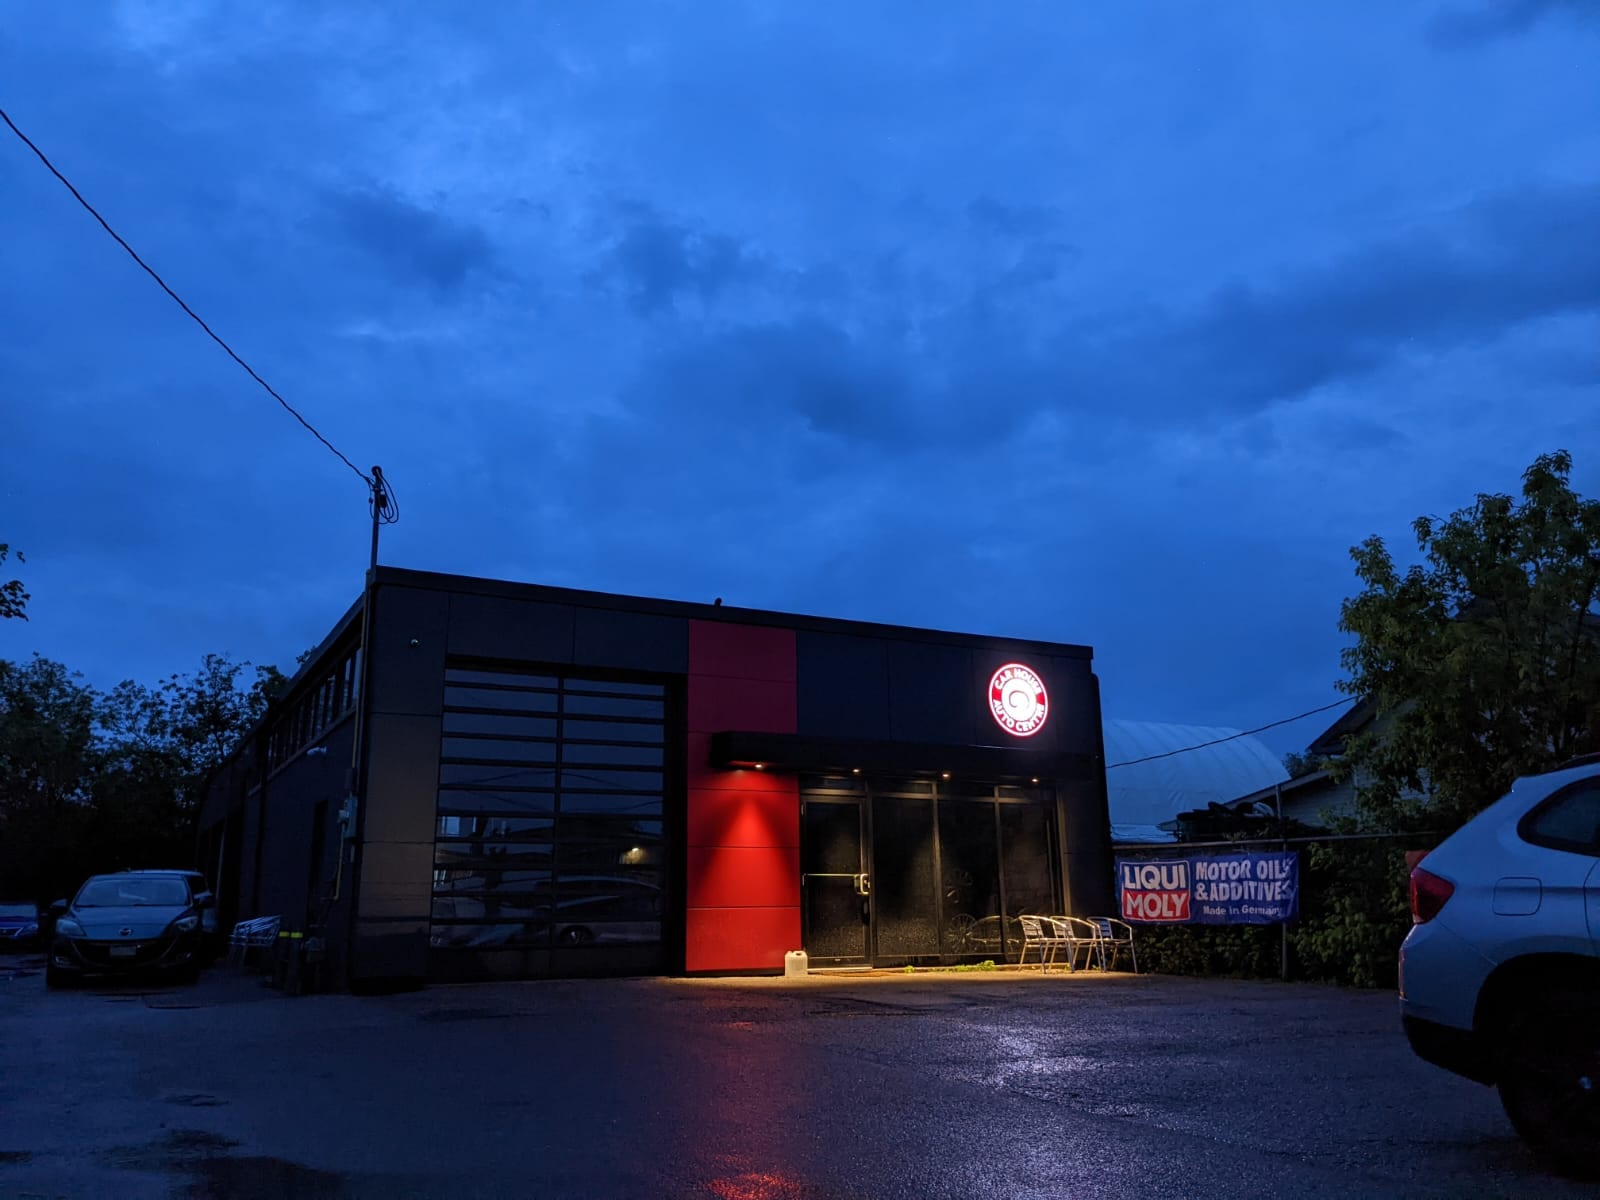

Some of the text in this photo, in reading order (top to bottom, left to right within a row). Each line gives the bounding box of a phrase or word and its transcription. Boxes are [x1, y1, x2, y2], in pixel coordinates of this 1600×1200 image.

[994, 670, 1013, 690] CAR
[993, 699, 1015, 727] AUTO
[1123, 864, 1186, 890] LIQUI
[1195, 860, 1251, 880] MOTOR
[1126, 892, 1187, 918] MOLY
[1203, 905, 1227, 915] Made
[1229, 906, 1240, 915] in
